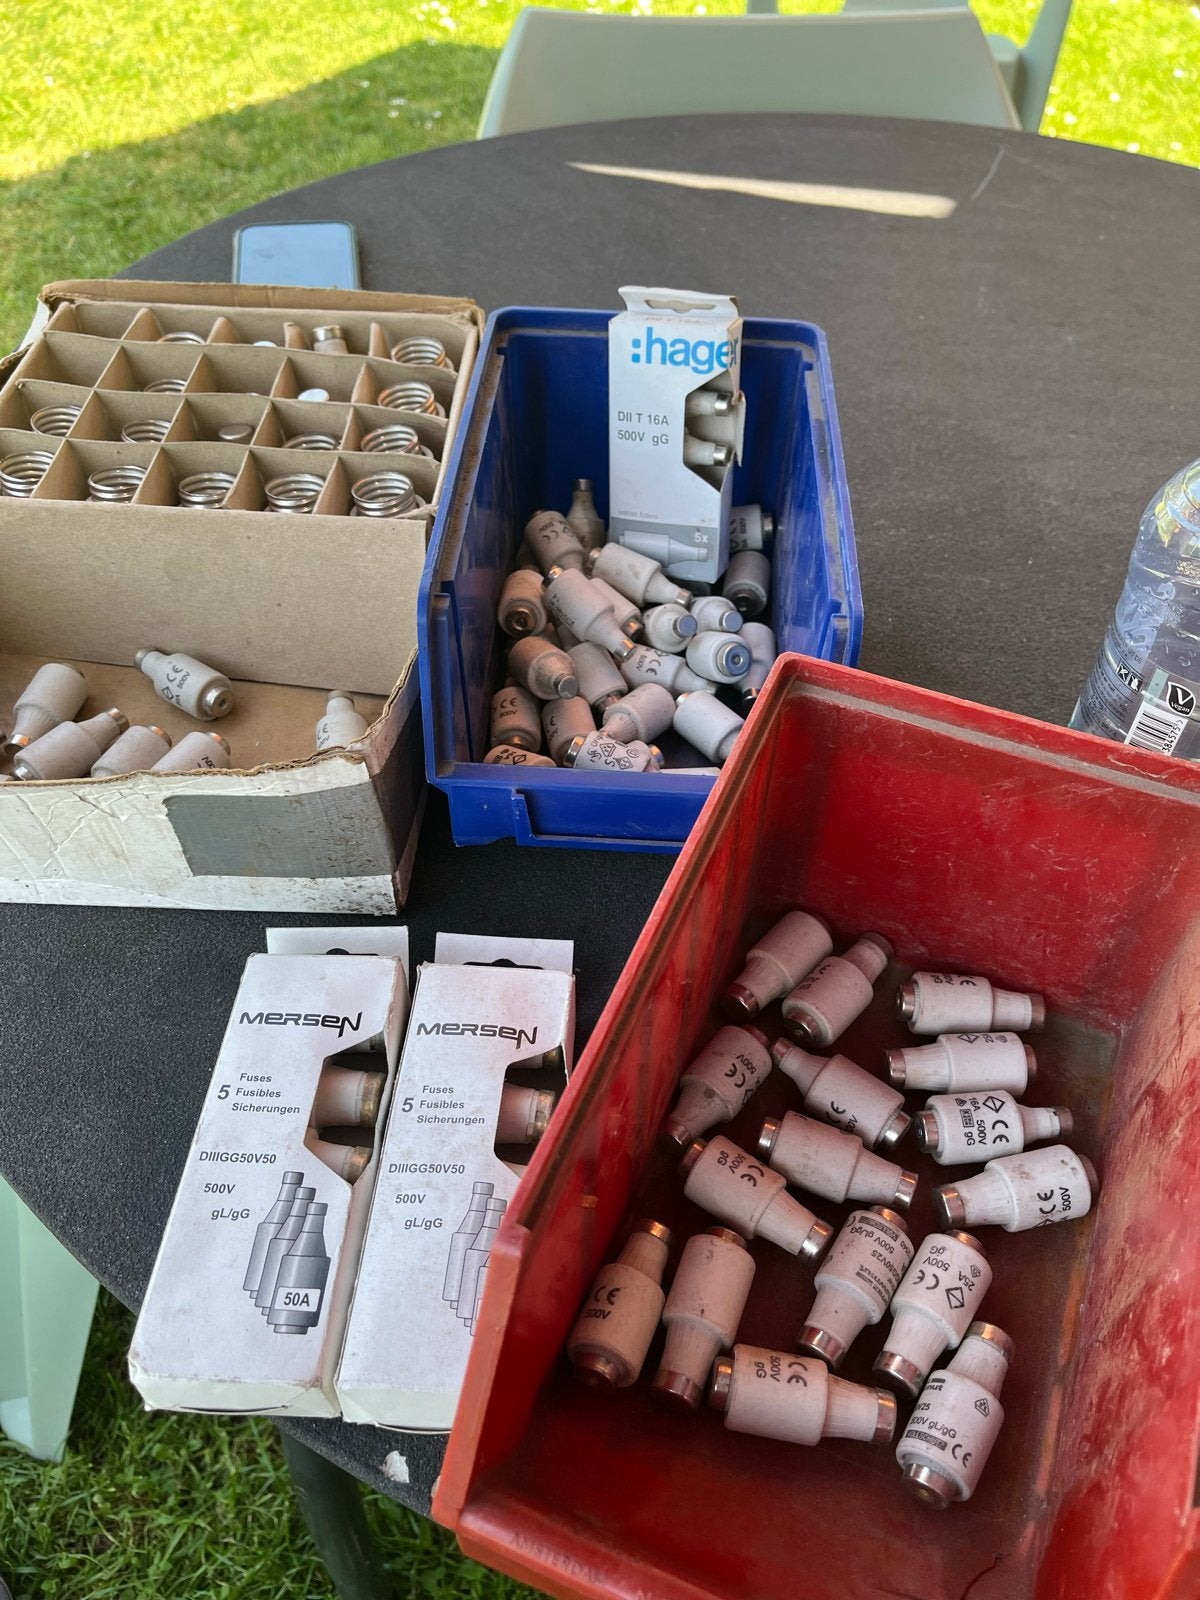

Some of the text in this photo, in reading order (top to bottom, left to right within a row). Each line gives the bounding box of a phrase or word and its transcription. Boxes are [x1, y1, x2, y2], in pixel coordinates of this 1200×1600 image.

[635, 411, 643, 424] T
[647, 413, 669, 426] 16A
[617, 429, 669, 447] 500V gG
[694, 531, 710, 544] 5x
[1170, 701, 1190, 713] Vegan
[736, 1054, 757, 1076] 500V
[239, 1072, 273, 1083] Fuses
[217, 1084, 282, 1101] 5 Fusibles
[422, 1085, 455, 1095] Fuses
[231, 1102, 301, 1116] Sicherungen
[401, 1097, 465, 1113] 5 Fusibles
[416, 1114, 486, 1126] Sicherungen
[968, 1097, 987, 1146] 16A 500V
[966, 1131, 977, 1147] gG
[198, 1151, 277, 1165] DIIIGG50V50
[717, 1150, 730, 1167] gG
[728, 1153, 748, 1174] 500V
[388, 1162, 466, 1175] DIIIGG50V50
[203, 1183, 236, 1195] 500V
[395, 1193, 427, 1205] 500V
[1059, 1186, 1072, 1211] 500V
[211, 1207, 251, 1222] gL/gG
[404, 1217, 444, 1231] gL/gG
[873, 1235, 896, 1255] 500V
[929, 1245, 946, 1256] gG
[922, 1256, 976, 1293] 25A 500V
[283, 1292, 311, 1308] 50A
[756, 1361, 768, 1379] gG
[769, 1355, 781, 1383] 500V
[927, 1420, 958, 1440] gL/gG
